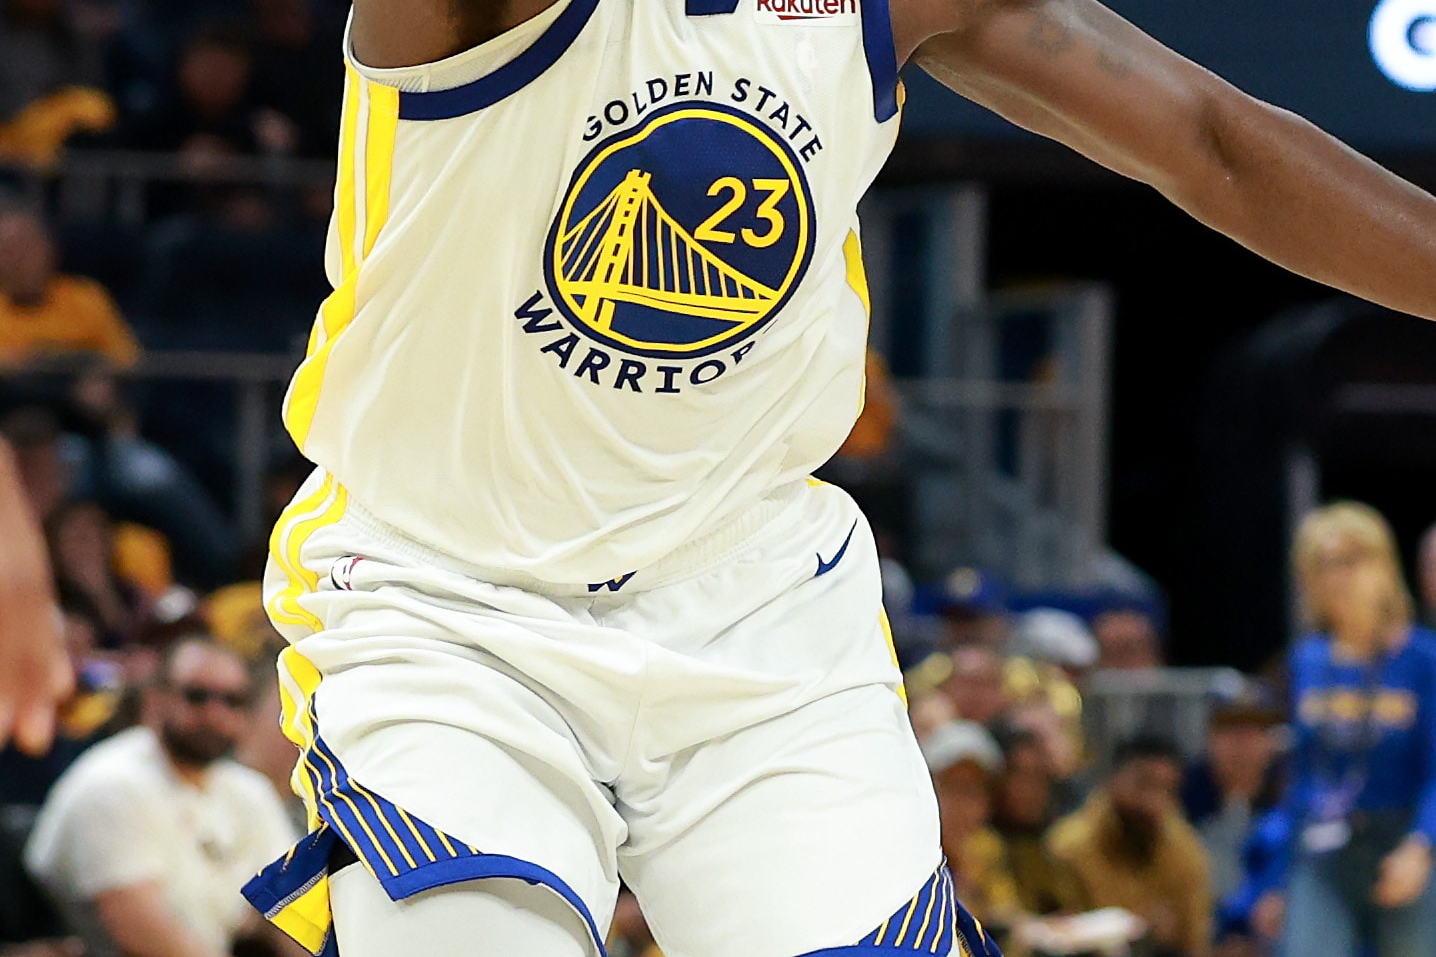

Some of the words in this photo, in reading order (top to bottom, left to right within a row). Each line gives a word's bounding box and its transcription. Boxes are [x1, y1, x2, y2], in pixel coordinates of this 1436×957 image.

[582, 71, 714, 142] GOLDEN
[731, 77, 823, 163] STATE
[693, 176, 791, 248] 23
[513, 290, 779, 394] WARRIOR
